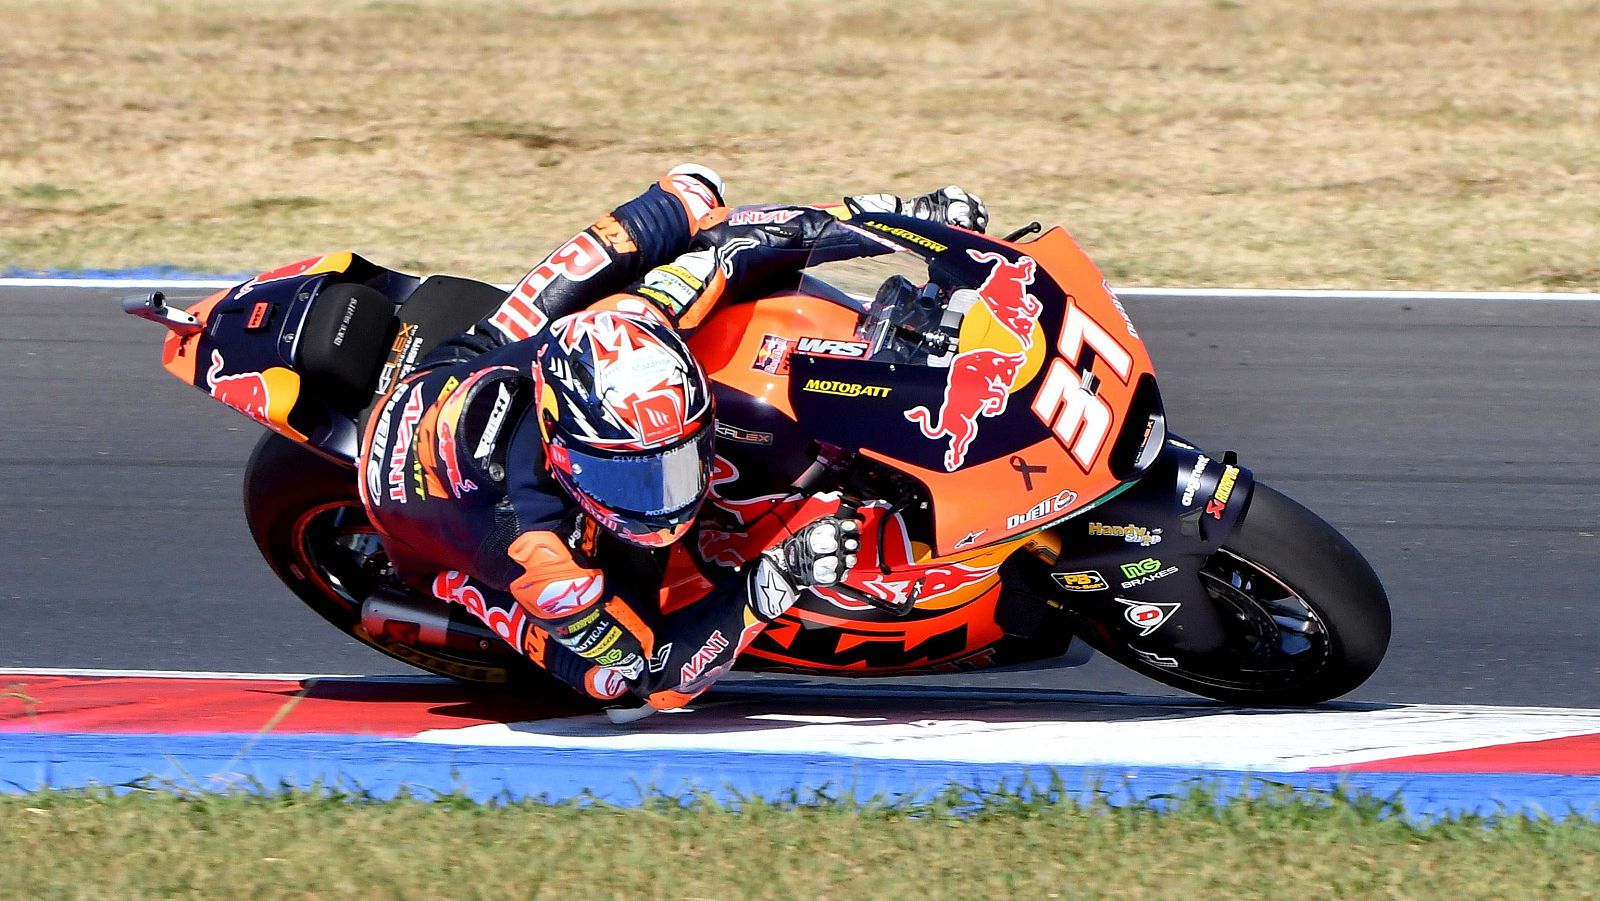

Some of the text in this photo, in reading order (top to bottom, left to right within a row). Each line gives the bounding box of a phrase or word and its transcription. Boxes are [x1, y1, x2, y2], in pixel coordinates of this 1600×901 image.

[729, 210, 804, 226] AVANT
[864, 220, 948, 252] MOTOBATT
[375, 321, 415, 395] KALEX
[796, 337, 869, 358] WRS
[803, 379, 892, 398] MOTOBATT
[1030, 299, 1134, 472] 37
[388, 382, 424, 504] AVANT
[1182, 455, 1210, 506] augment
[1089, 522, 1146, 540] Handy
[1064, 574, 1092, 586] PB
[1121, 566, 1178, 589] BRAKES
[680, 629, 730, 687] AVANT
